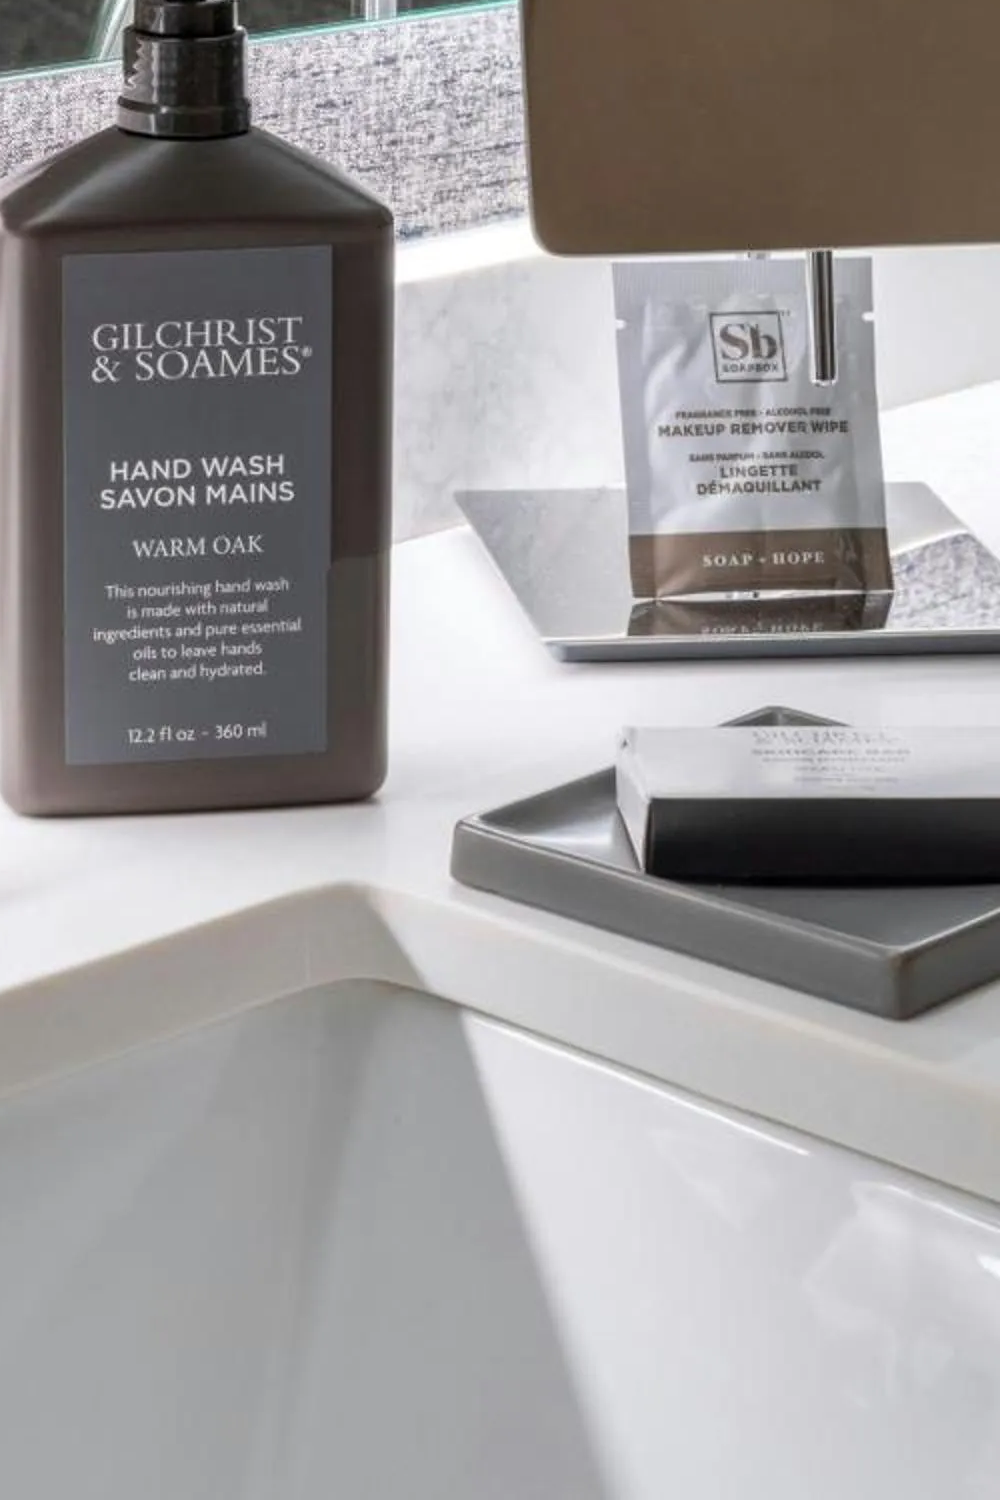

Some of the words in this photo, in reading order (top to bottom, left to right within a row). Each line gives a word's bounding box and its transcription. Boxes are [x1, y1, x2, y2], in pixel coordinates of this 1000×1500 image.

[91, 316, 303, 352] GILCHRIST
[720, 323, 778, 360] Sb
[90, 354, 121, 384] &
[657, 422, 726, 438] MAKEUP
[730, 419, 808, 436] REMOVER
[810, 418, 849, 434] WIPE
[109, 457, 193, 483] HAND
[200, 453, 286, 478] WASH
[719, 463, 799, 479] LINGETTE
[99, 484, 196, 510] SAVON
[205, 480, 296, 506] MAINS
[696, 478, 822, 496] DÉMAQUILLANT
[132, 537, 206, 559] WARM
[212, 534, 265, 555] OAK
[702, 553, 753, 568] SOAP
[772, 551, 825, 566] HOPE
[104, 584, 135, 600] This
[137, 580, 213, 599] nourishing
[215, 578, 251, 594] hand
[254, 576, 290, 592] wash
[126, 604, 139, 620] is
[141, 602, 182, 618] made
[184, 600, 217, 616] with
[219, 598, 270, 615] natural
[92, 624, 173, 646] ingredients
[174, 622, 202, 638] and
[205, 623, 238, 641] pure
[240, 616, 303, 634] essential
[132, 645, 158, 662] oils
[160, 646, 178, 661] to
[180, 643, 218, 659] leave
[220, 640, 264, 656] hands
[128, 666, 168, 683] clean
[169, 663, 198, 680] and
[199, 660, 267, 682] hydrated.
[127, 726, 156, 745] 12.2
[159, 725, 172, 742] fl
[175, 728, 196, 742] oz
[214, 723, 244, 740] 360
[246, 720, 268, 739] ml
